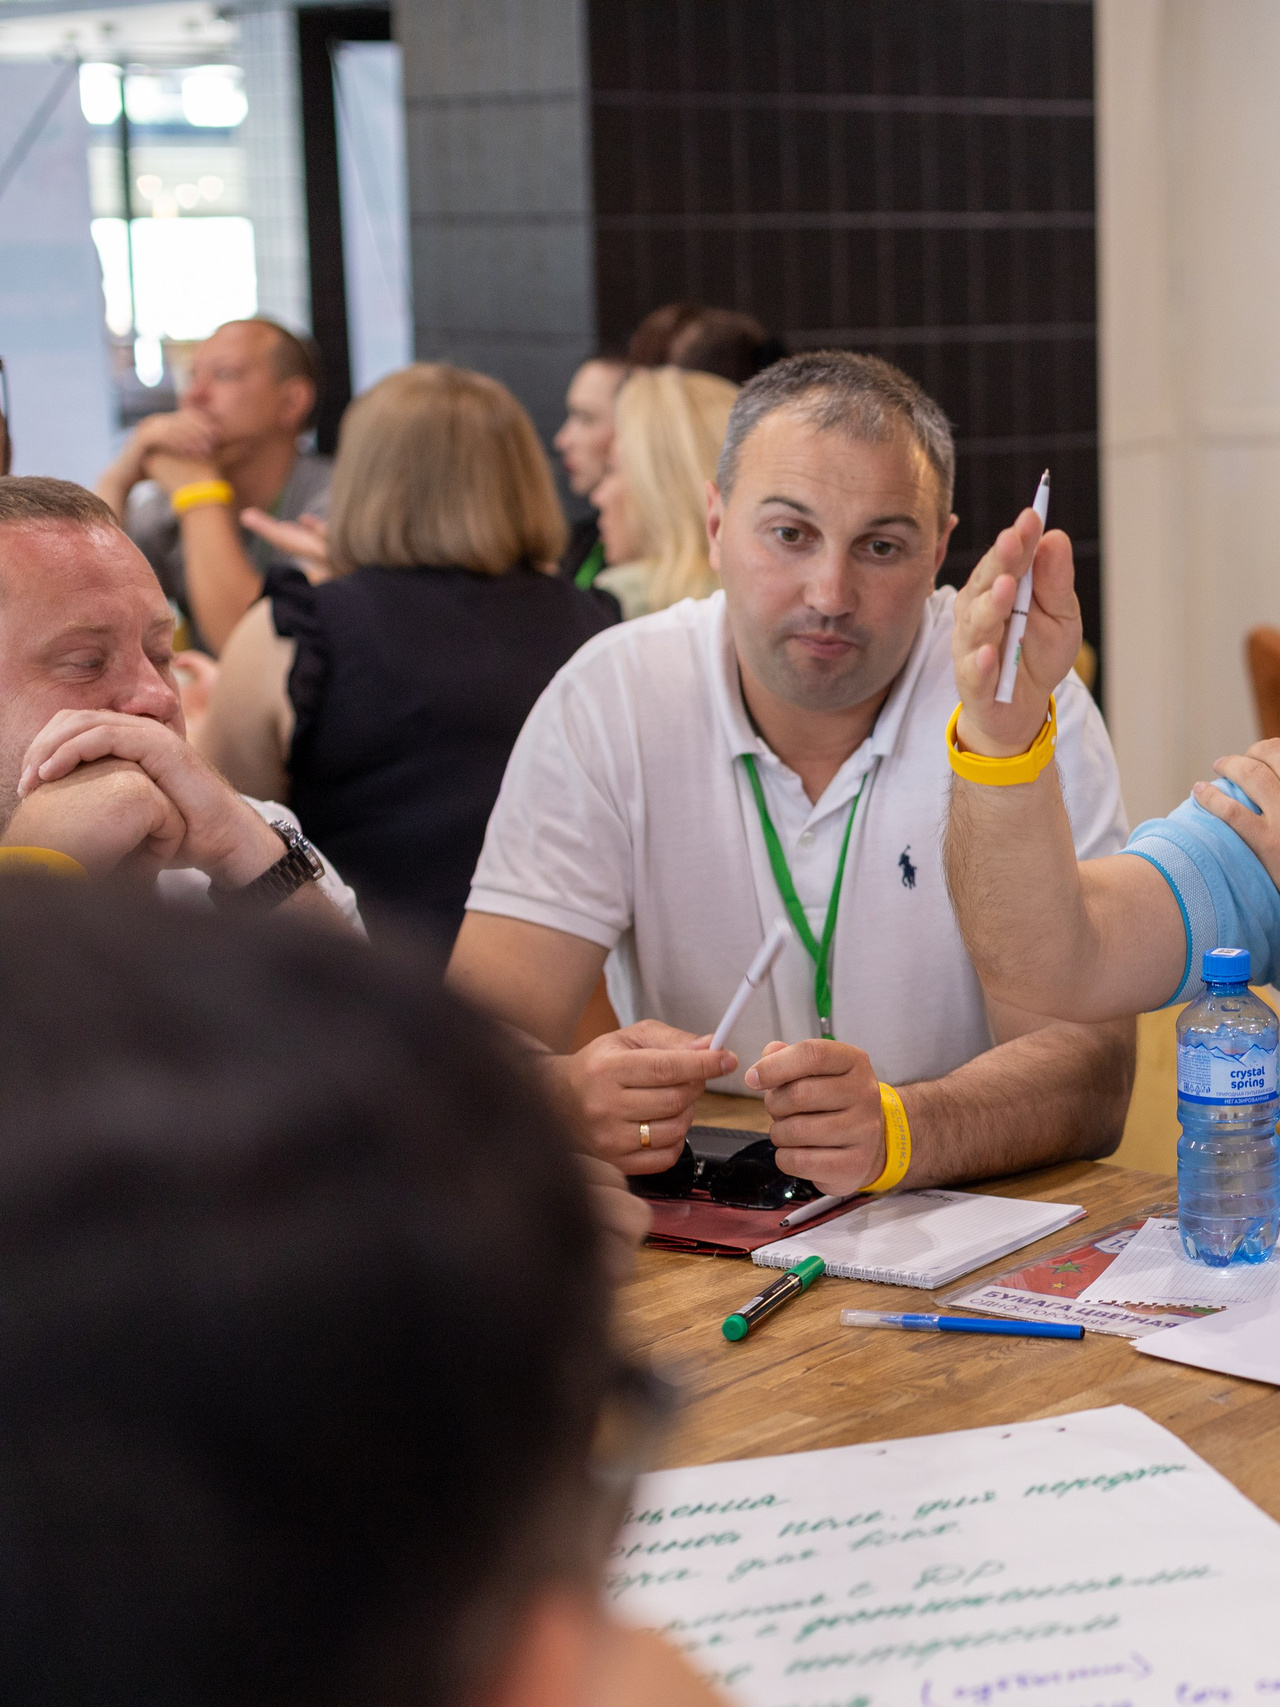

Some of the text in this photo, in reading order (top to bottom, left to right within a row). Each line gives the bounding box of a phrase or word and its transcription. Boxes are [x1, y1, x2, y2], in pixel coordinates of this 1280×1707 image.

[1230, 1065, 1265, 1080] crystal
[1231, 1078, 1264, 1090] spring
[1224, 1095, 1269, 1104] НЕГАЗИРОВАННАЯ
[969, 1298, 1110, 1328] ОДНОСТОРОННЯЯ
[981, 1290, 1181, 1330] БУМАГА ЦВЕТНАЯ
